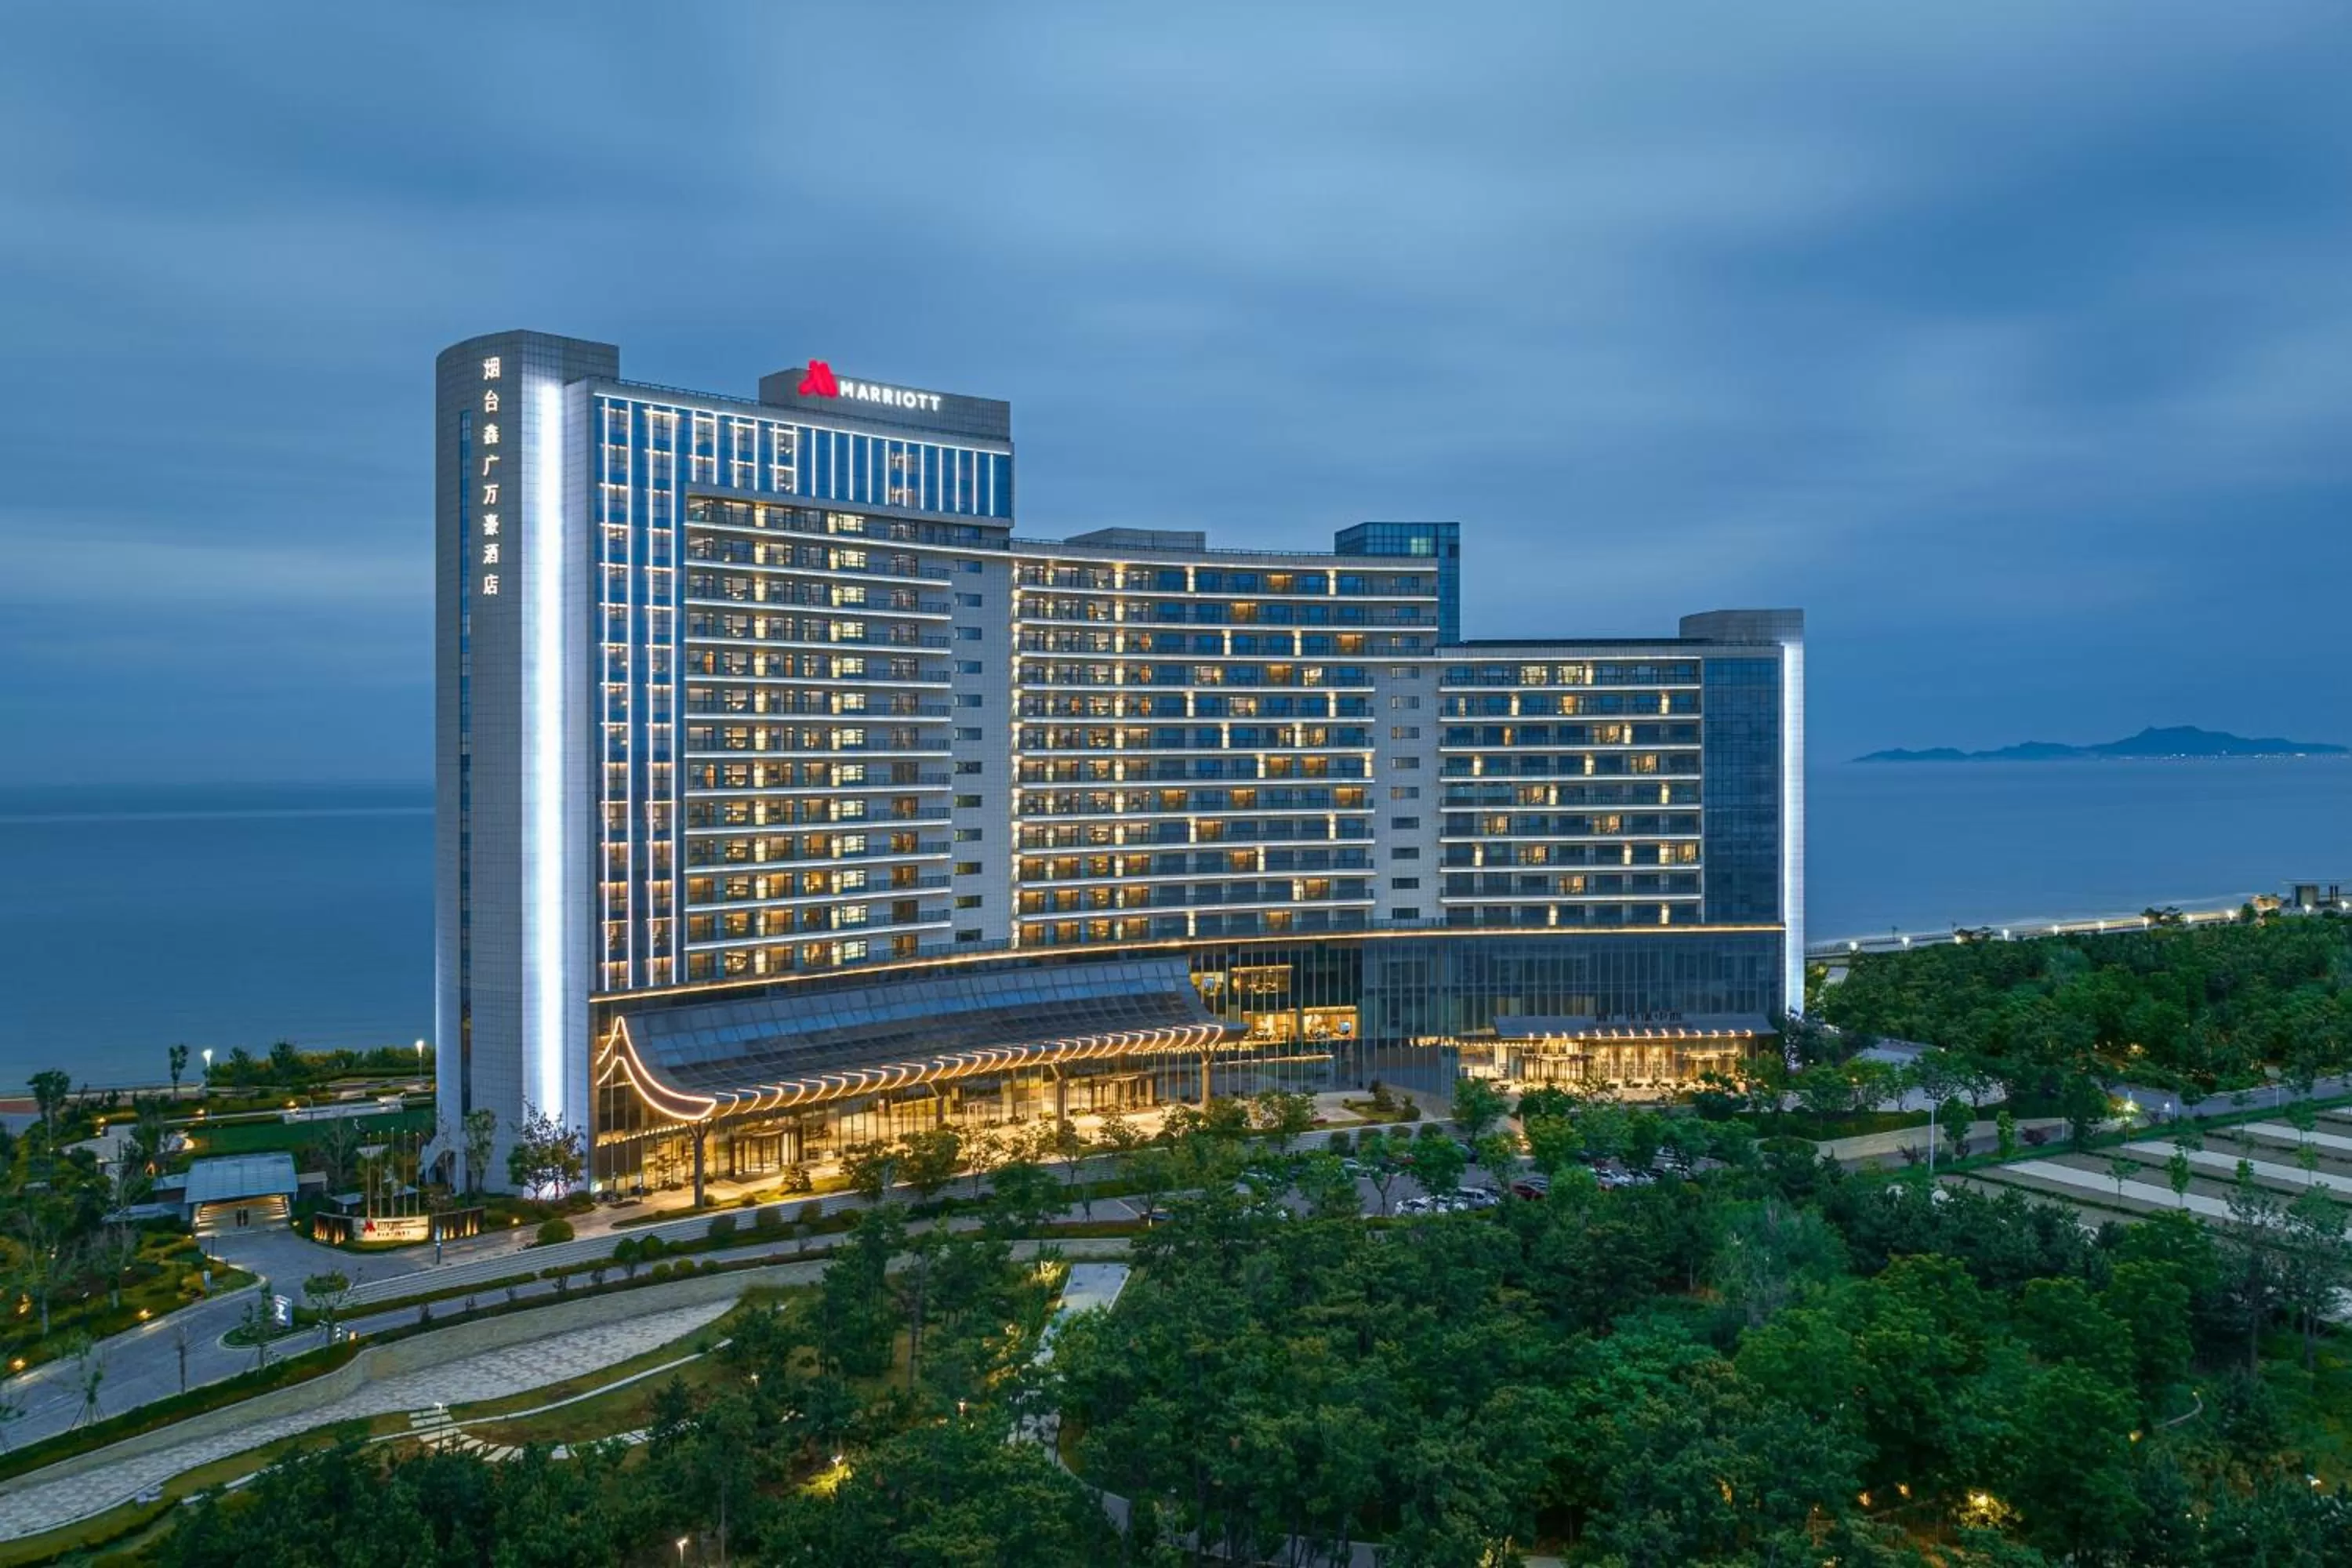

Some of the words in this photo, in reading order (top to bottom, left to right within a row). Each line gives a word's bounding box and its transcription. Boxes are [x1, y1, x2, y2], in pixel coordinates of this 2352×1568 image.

[839, 380, 941, 411] MARRIOTT
[482, 357, 500, 595] 烟台鑫广万豪酒店
